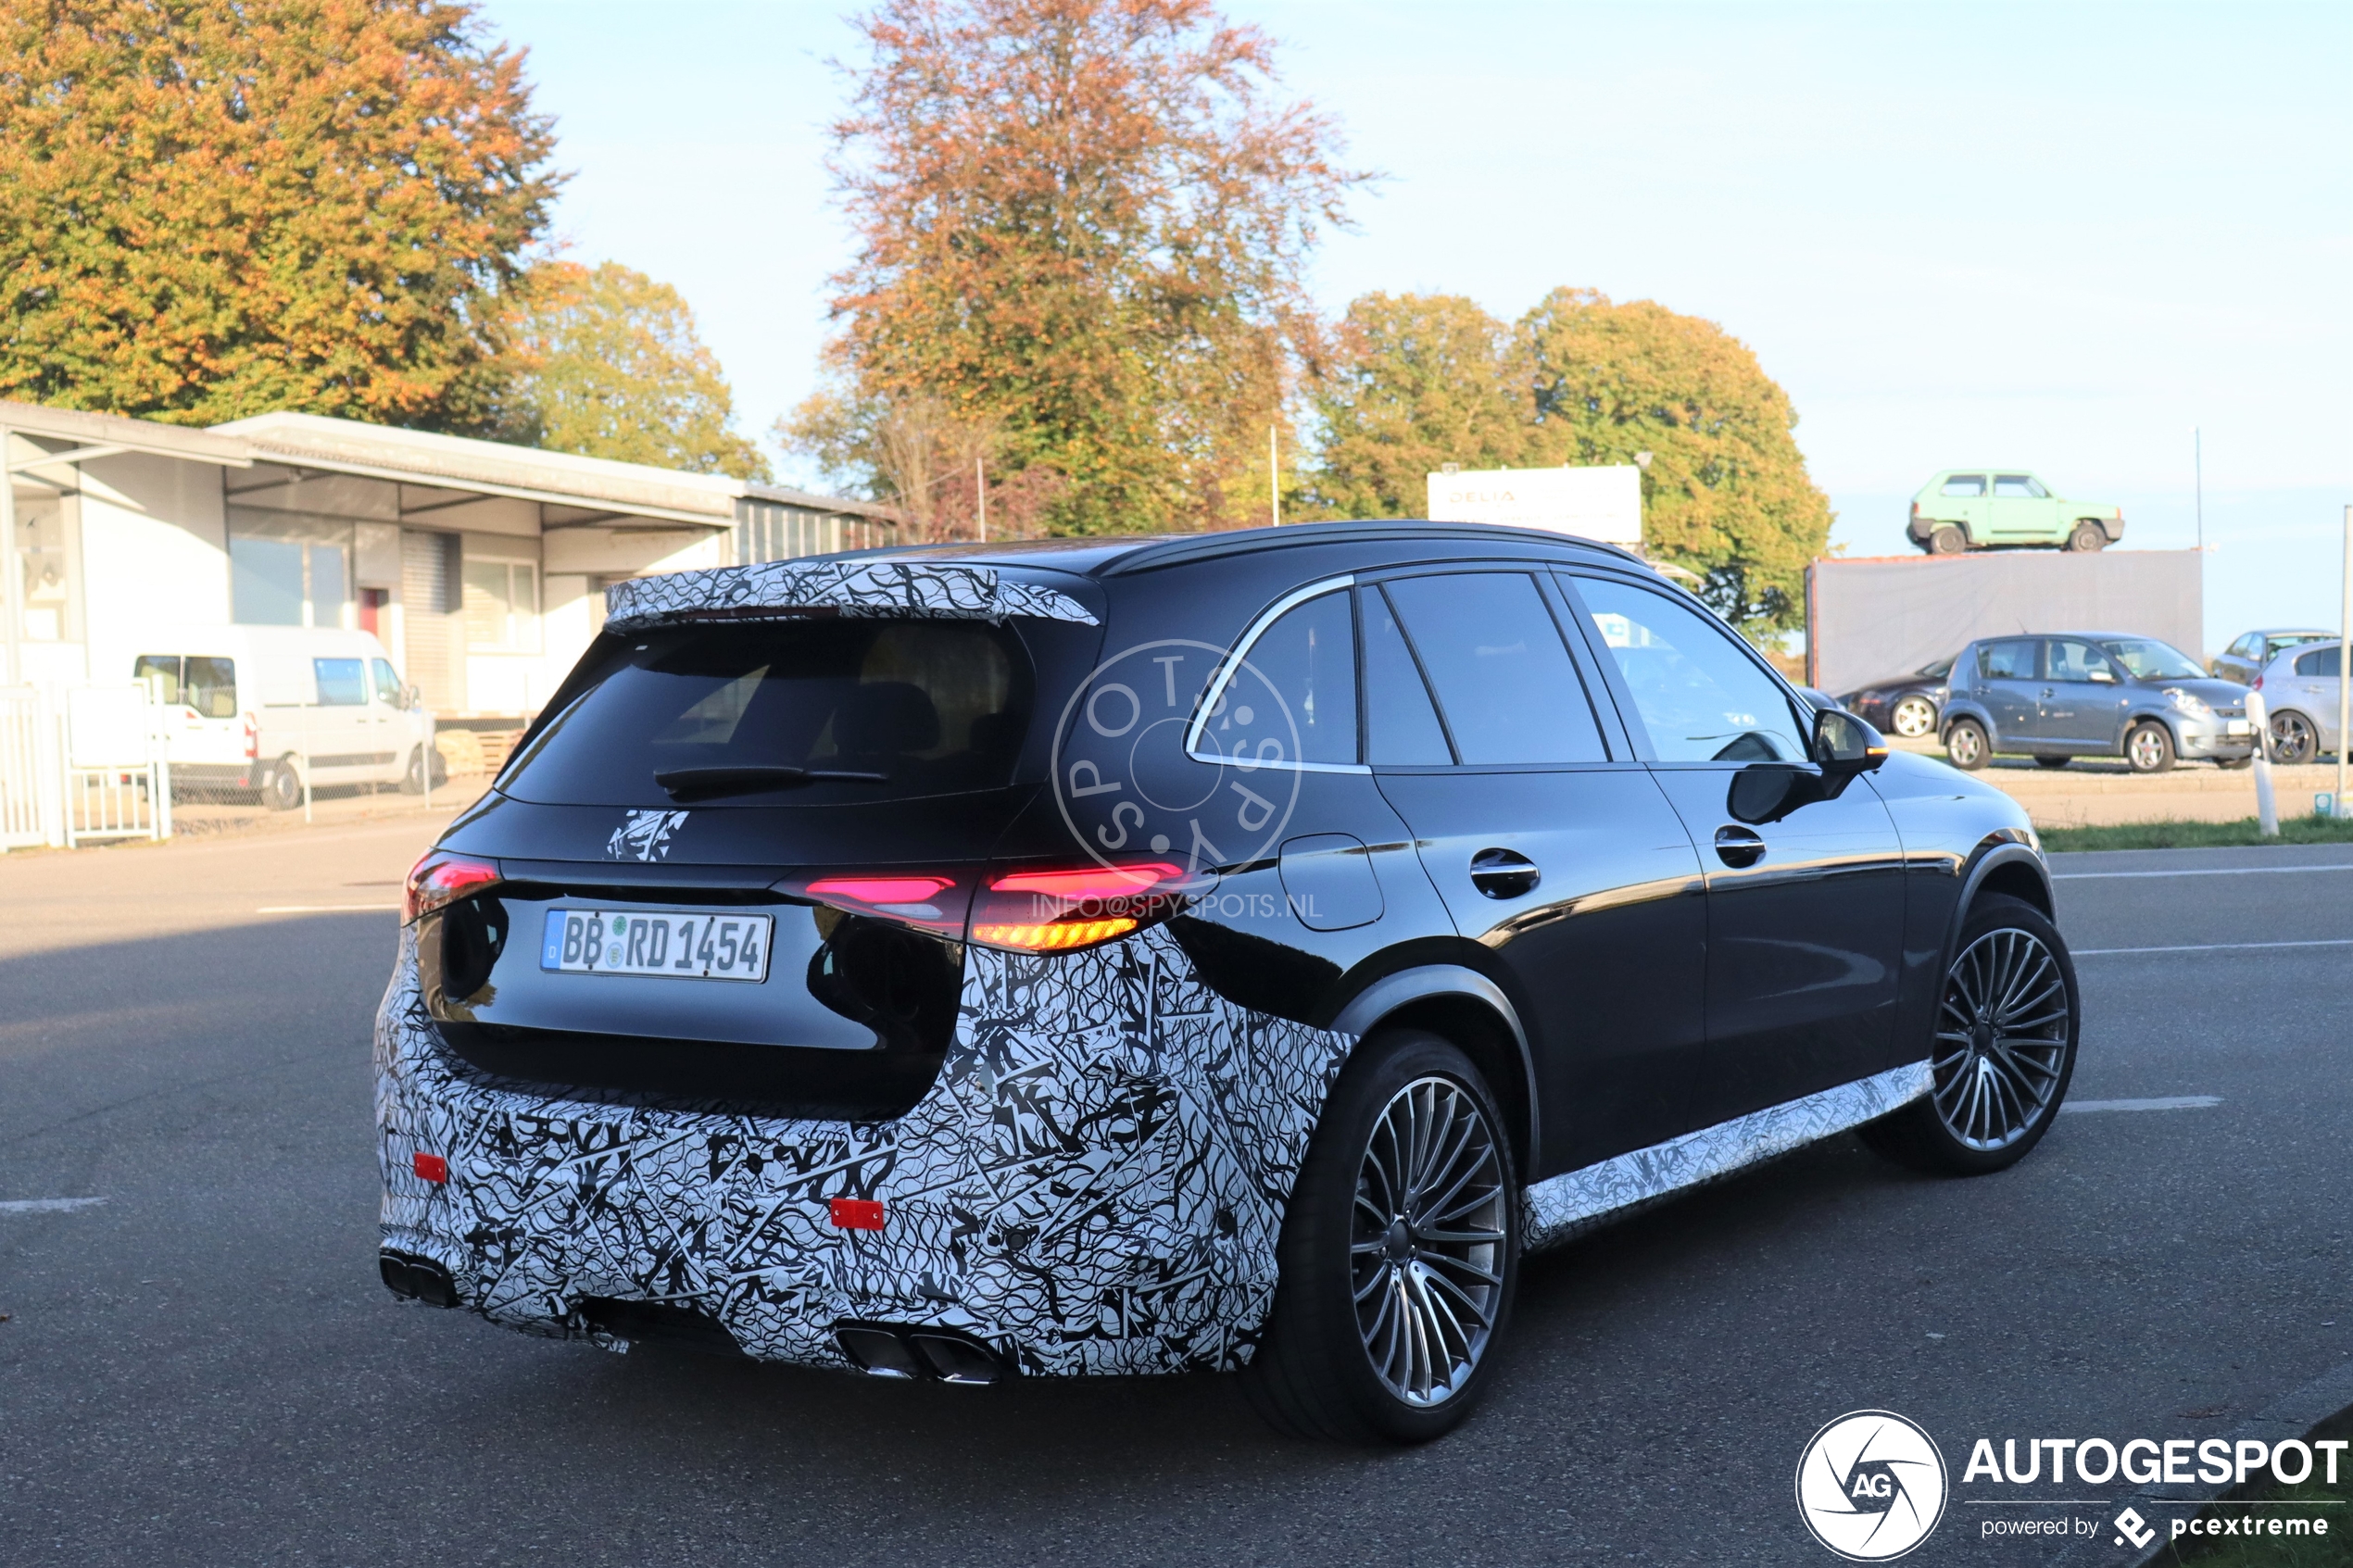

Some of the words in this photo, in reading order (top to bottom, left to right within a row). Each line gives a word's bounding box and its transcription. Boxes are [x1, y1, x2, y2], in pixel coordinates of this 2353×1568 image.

[548, 946, 557, 960] D
[563, 917, 603, 964] BB
[626, 919, 669, 967] RD
[675, 921, 759, 972] 1454
